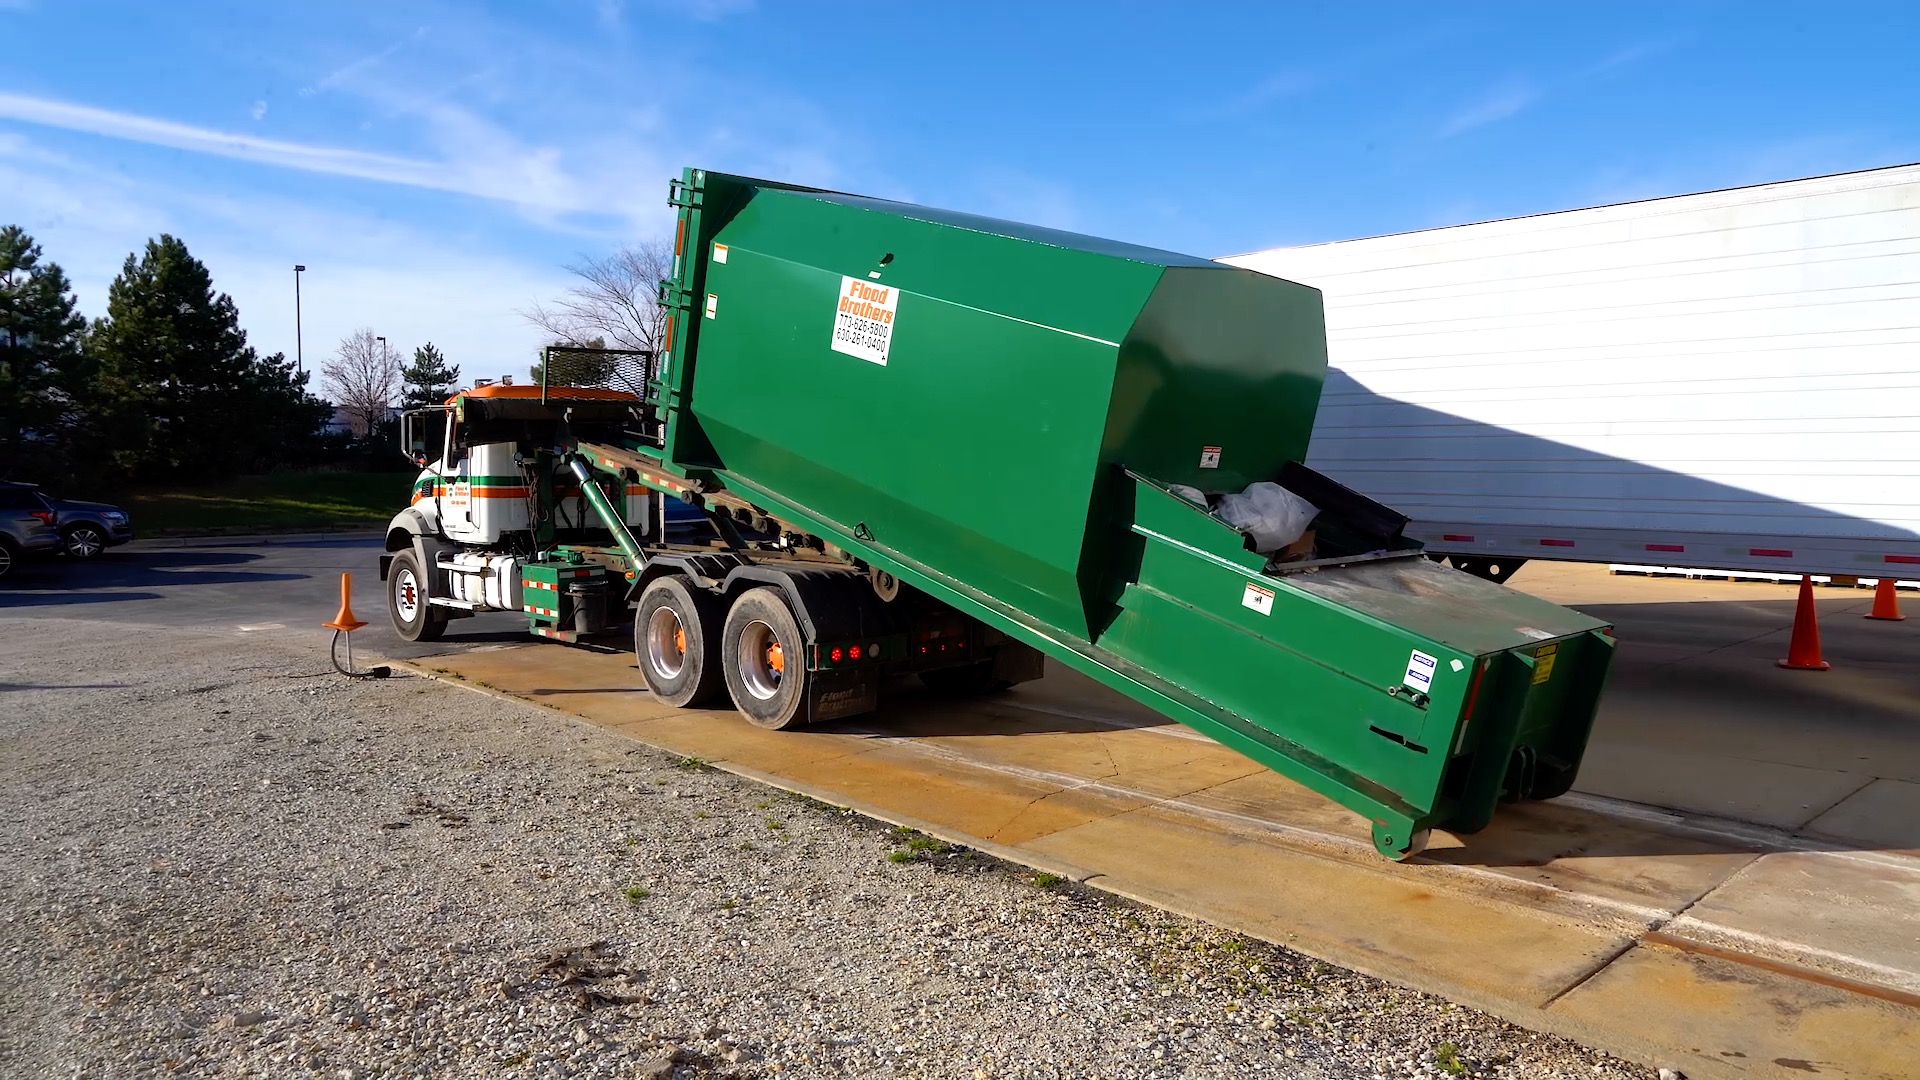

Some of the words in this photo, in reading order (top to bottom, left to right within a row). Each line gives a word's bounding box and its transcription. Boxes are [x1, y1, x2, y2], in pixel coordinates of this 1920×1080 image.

[849, 280, 889, 305] Flood
[839, 296, 893, 324] Brothers
[839, 313, 889, 338] 773-626-5800
[836, 327, 886, 353] 630-261-0400
